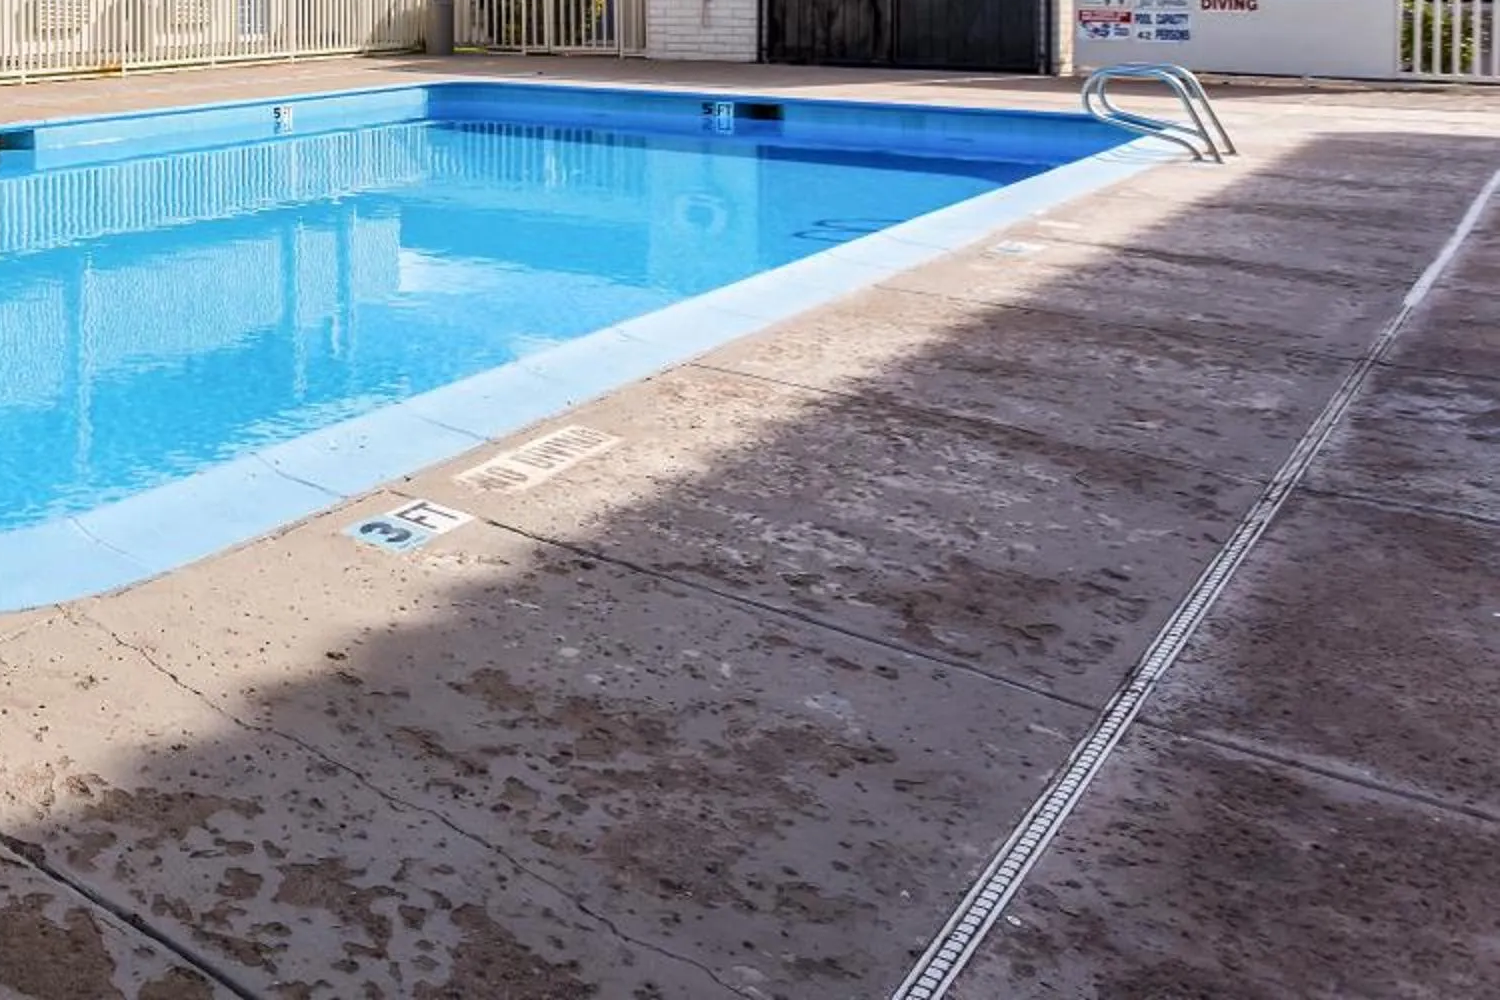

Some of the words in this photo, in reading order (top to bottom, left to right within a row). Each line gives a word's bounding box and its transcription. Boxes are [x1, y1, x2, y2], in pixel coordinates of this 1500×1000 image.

[273, 107, 281, 119] 5
[359, 520, 413, 544] 3
[396, 502, 459, 530] FT
